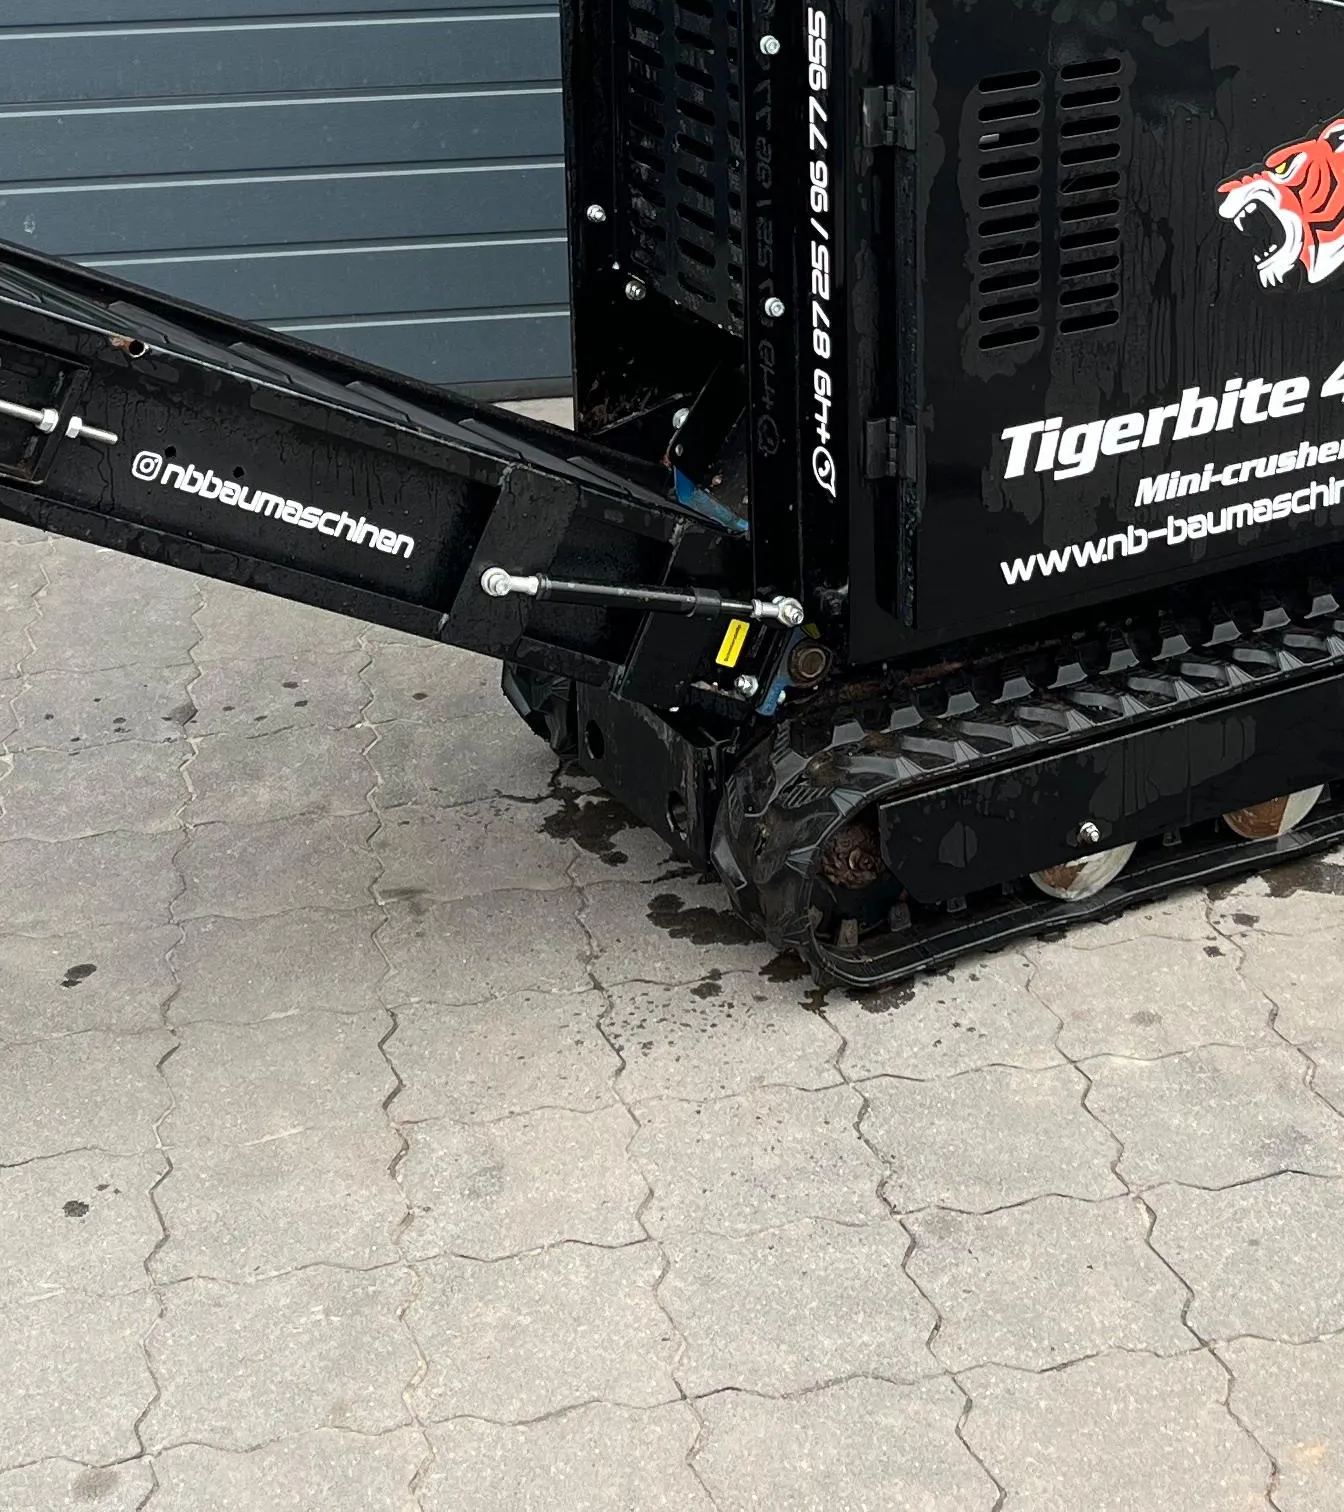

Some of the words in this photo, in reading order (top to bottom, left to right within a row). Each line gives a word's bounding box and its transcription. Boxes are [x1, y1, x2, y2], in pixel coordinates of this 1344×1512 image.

[807, 7, 827, 91] 955
[809, 160, 829, 213] 96
[810, 240, 831, 359] 8725
[813, 368, 832, 445] +49
[1000, 376, 1312, 482] Tigerbite
[160, 463, 415, 559] nbbaumaschinen
